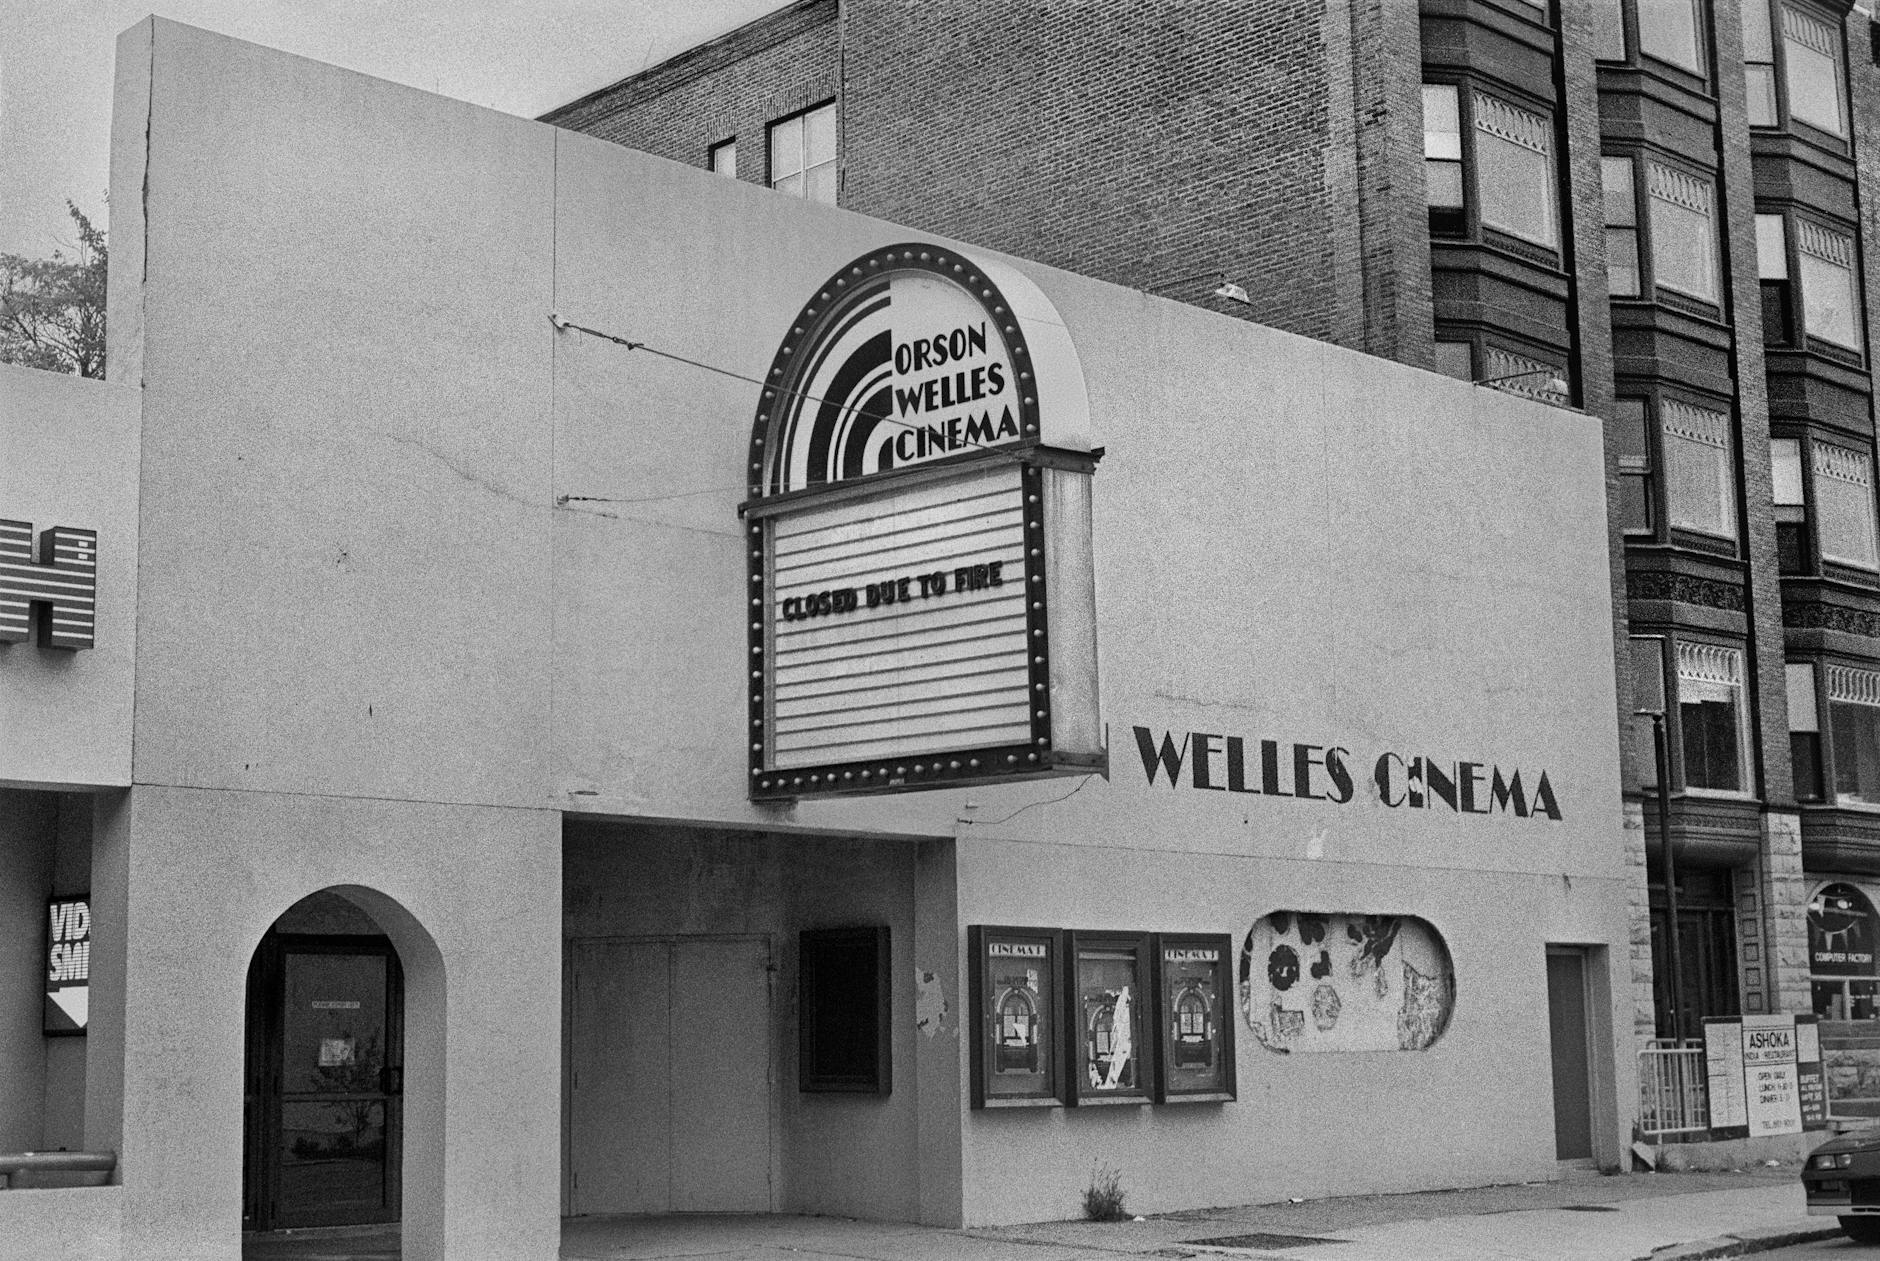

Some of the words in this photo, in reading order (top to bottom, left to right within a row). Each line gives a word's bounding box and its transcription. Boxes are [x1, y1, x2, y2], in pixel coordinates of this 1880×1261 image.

[895, 321, 987, 376] ORSON
[895, 362, 1005, 418] WELLES
[895, 404, 1020, 462] CINEMA
[782, 587, 858, 622] CLOSED
[866, 576, 911, 609] DUE
[917, 571, 946, 599] TO
[954, 560, 1004, 592] FIRE
[1132, 725, 1354, 804] WELLES
[1374, 751, 1563, 821] CINEMA
[50, 901, 91, 942] VID
[990, 943, 1034, 955] CINEMA
[1166, 949, 1208, 960] CINEMA
[1815, 951, 1846, 962] COMPUTER
[1848, 953, 1873, 963] FACTORY
[1749, 1031, 1790, 1049] ASHOKA
